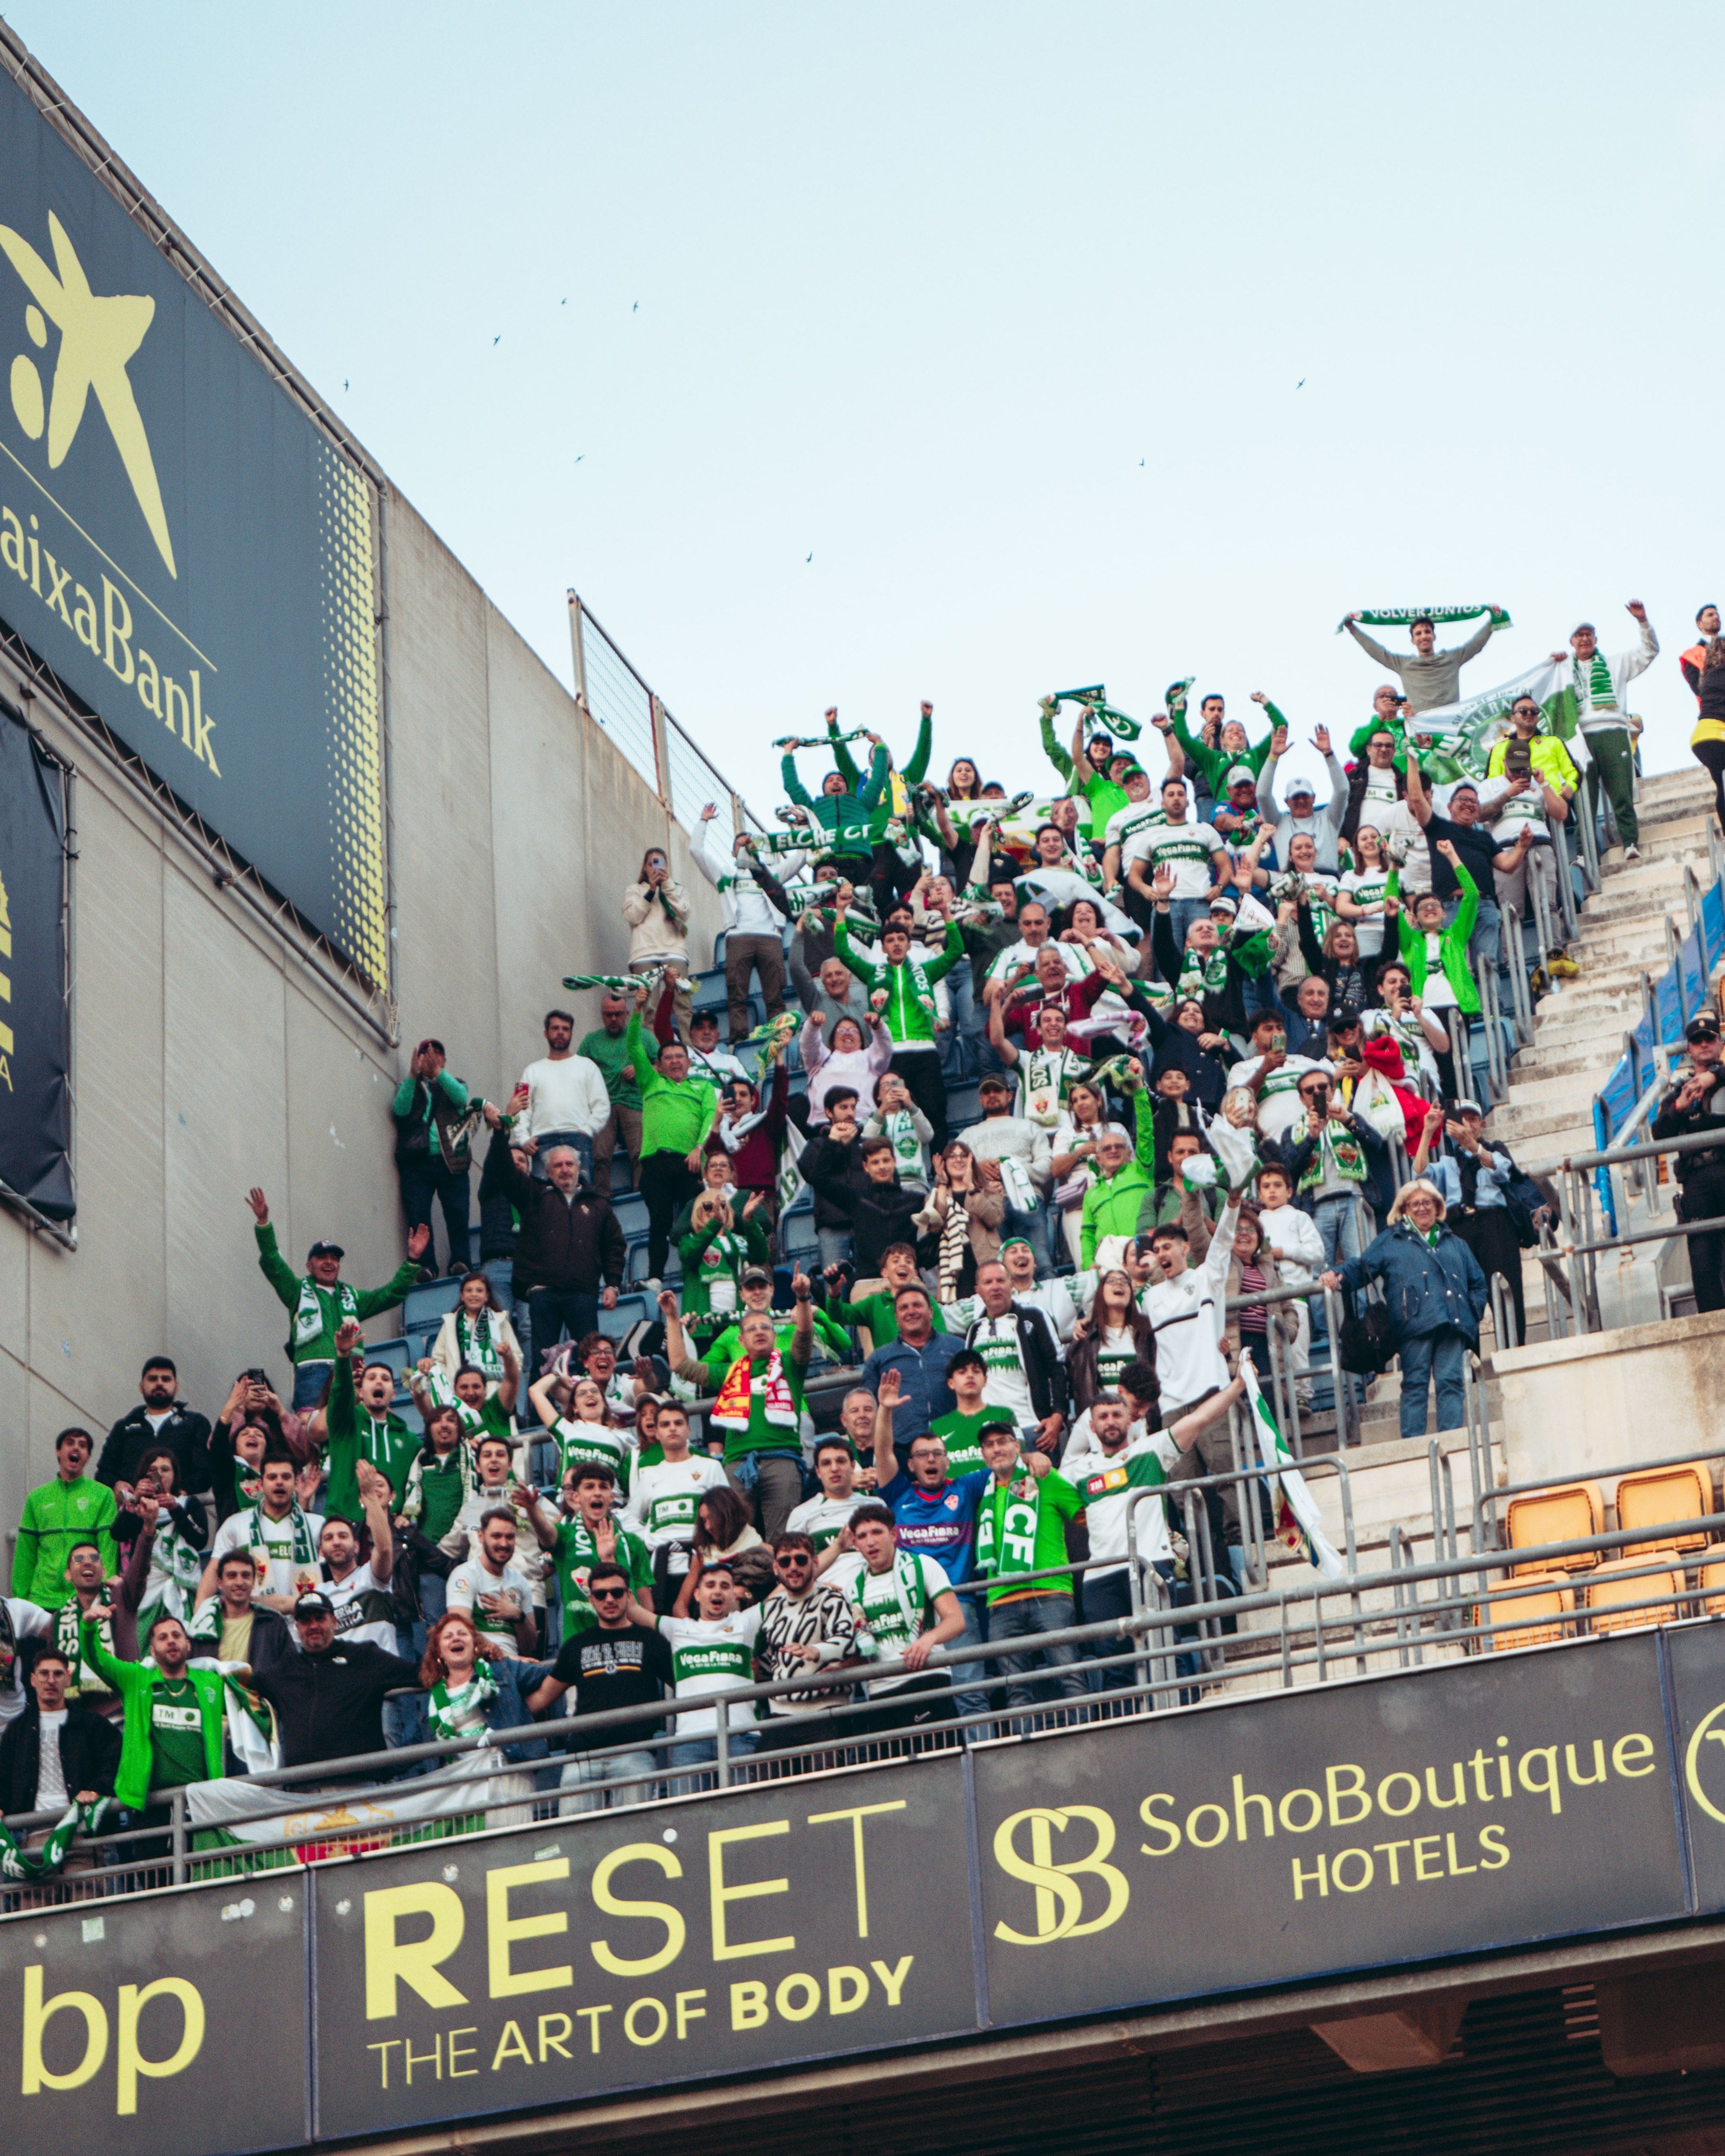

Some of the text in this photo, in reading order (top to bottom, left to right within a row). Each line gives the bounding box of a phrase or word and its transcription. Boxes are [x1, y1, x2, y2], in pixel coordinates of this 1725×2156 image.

[1, 506, 222, 777] aixaBank
[1369, 605, 1481, 618] VOLVER JUNTOS
[776, 829, 837, 849] ELCHE
[1090, 1478, 1103, 1491] TM
[1002, 1503, 1038, 1564] CF
[158, 1709, 174, 1720] TM
[1139, 1735, 1656, 1856] SohoBoutique
[1291, 1824, 1511, 1901] HOTELS
[363, 1799, 907, 2020] RESET
[22, 1964, 205, 2115] bp
[366, 1955, 914, 2089] THE ART OF BODY
